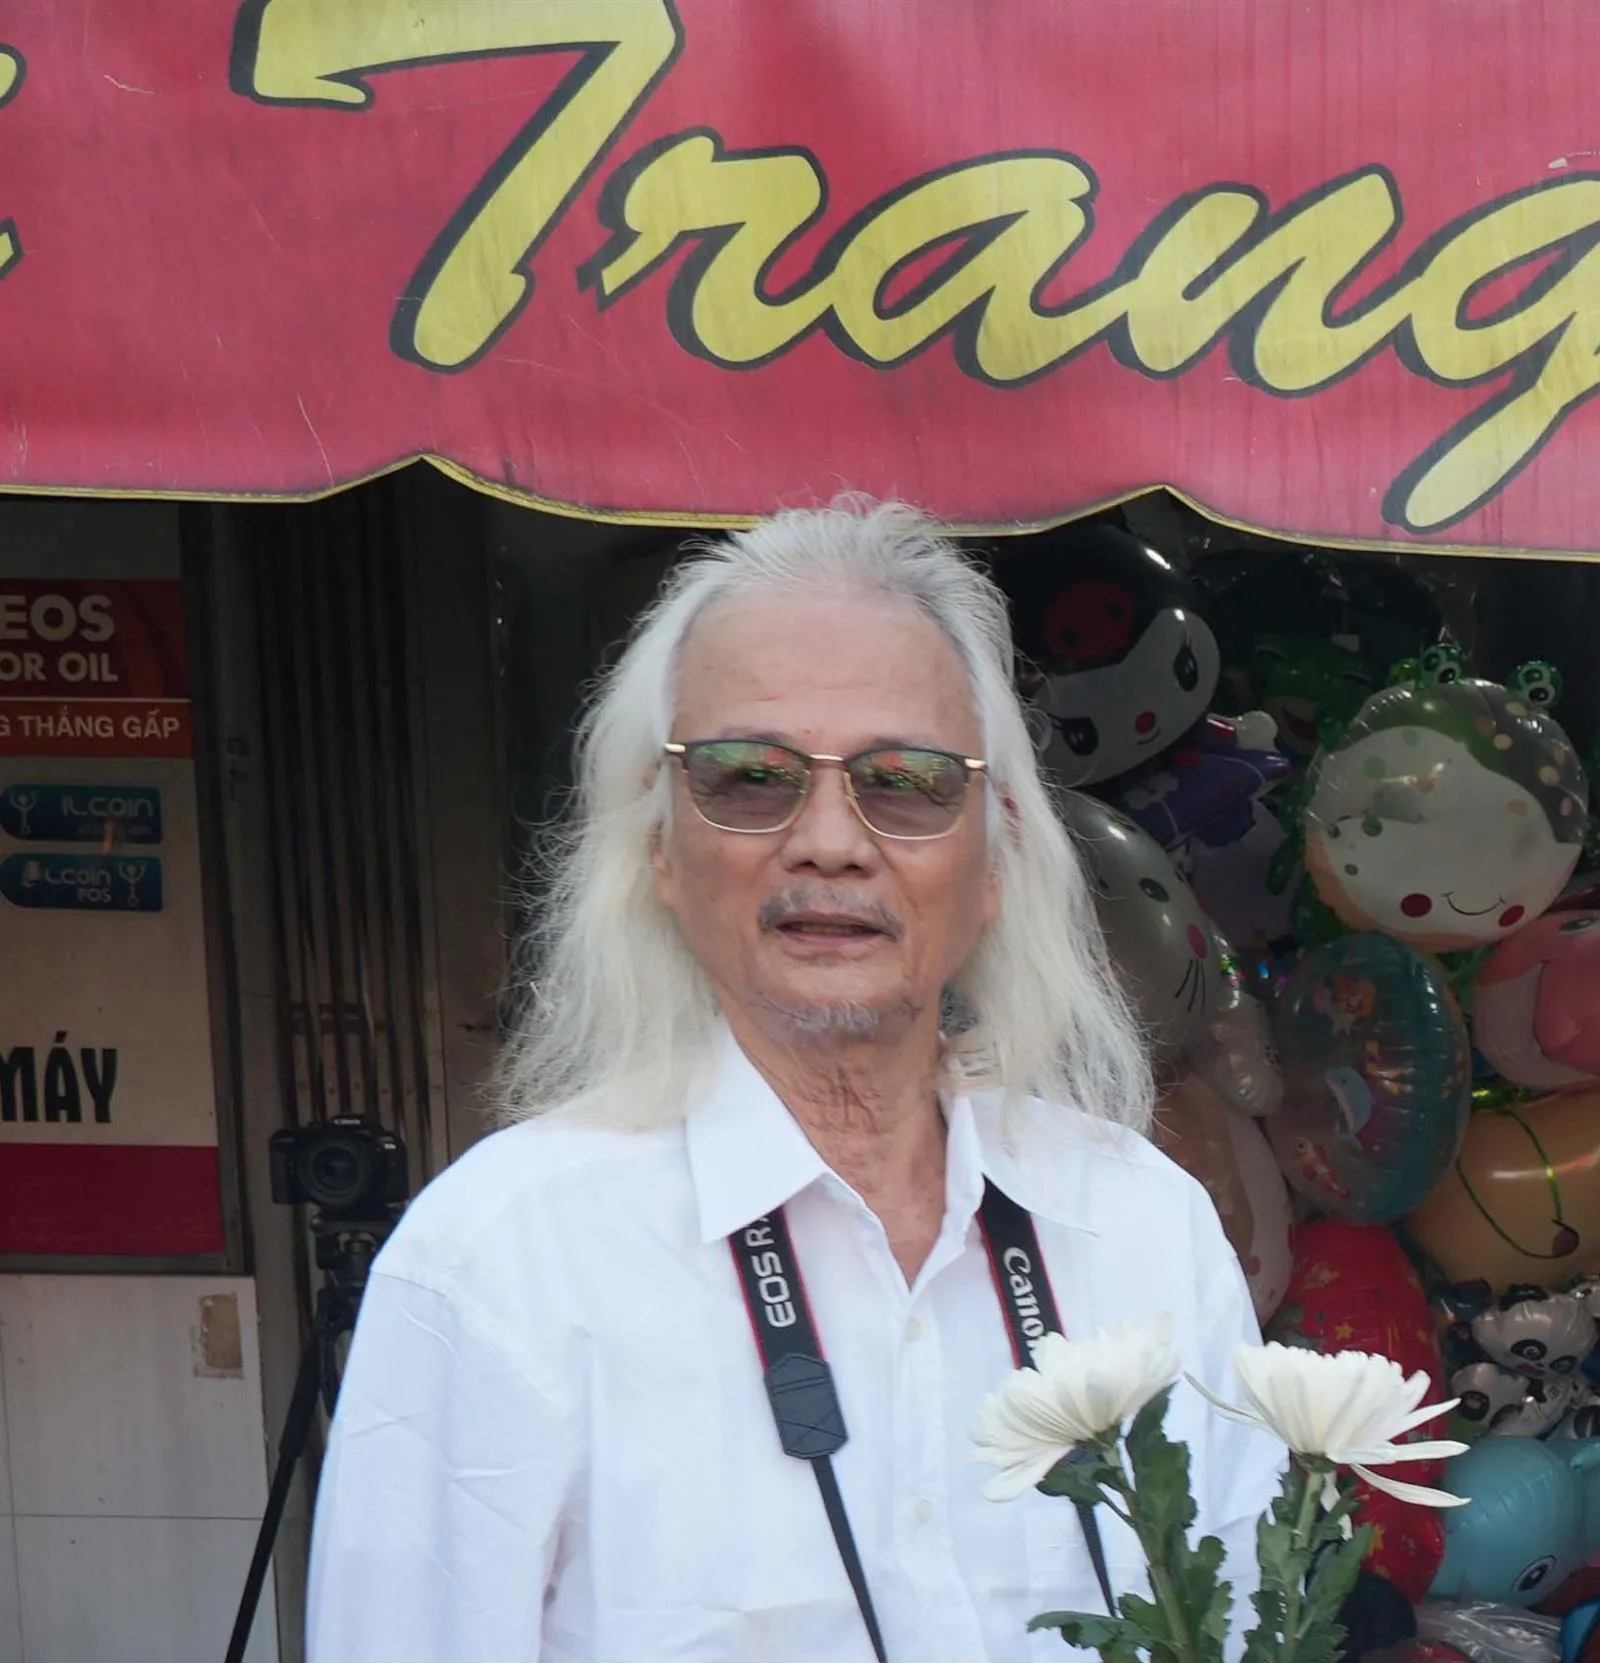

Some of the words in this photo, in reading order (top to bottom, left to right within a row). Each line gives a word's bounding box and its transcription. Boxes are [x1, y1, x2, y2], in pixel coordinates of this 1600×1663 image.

[58, 652, 119, 682] OIL
[0, 1030, 118, 1123] MÁY
[751, 1251, 797, 1328] EOS
